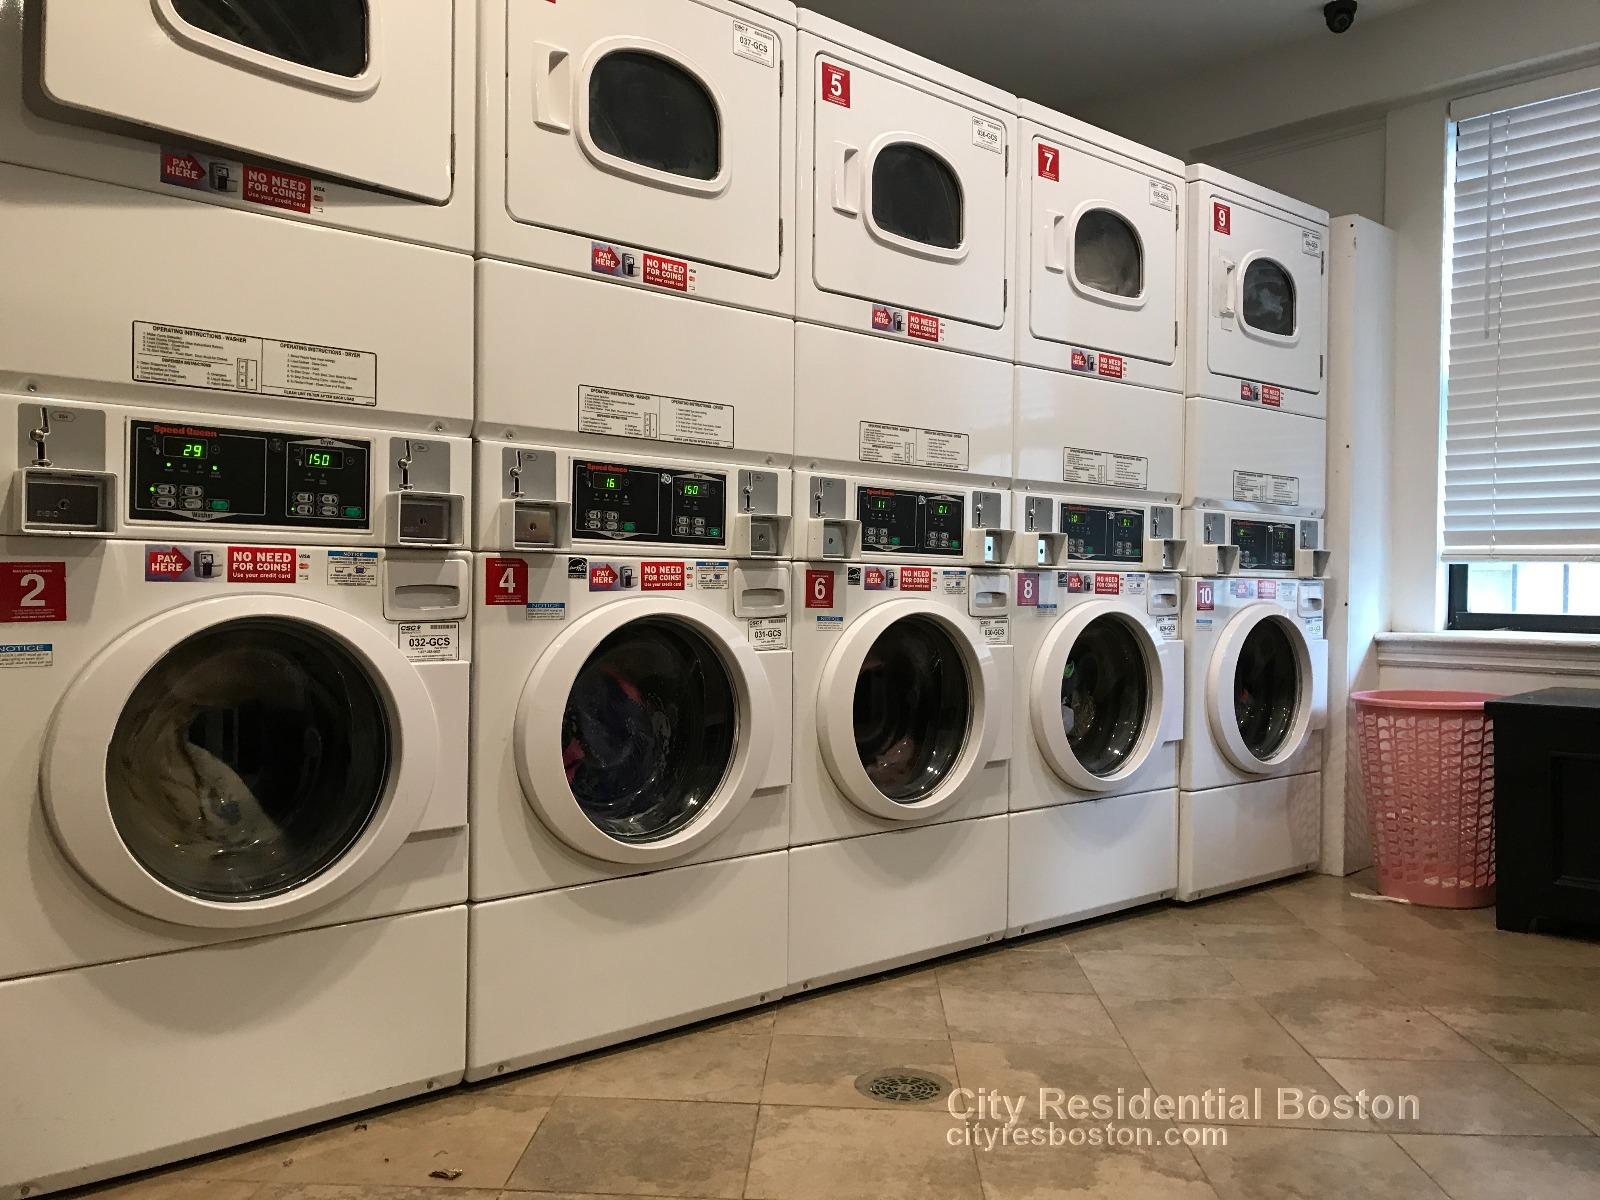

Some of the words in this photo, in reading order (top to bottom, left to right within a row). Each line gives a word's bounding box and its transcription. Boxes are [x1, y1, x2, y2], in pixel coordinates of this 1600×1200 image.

[740, 36, 768, 52] 037-GCS
[831, 74, 842, 96] 5
[172, 158, 193, 170] PAY
[1044, 152, 1054, 172] 7
[167, 165, 198, 180] HERE
[248, 170, 266, 182] NO
[272, 176, 306, 192] NEED
[248, 182, 268, 192] FOR
[272, 186, 306, 200] COINS!
[261, 194, 273, 202] your
[274, 196, 292, 206] credit
[1219, 210, 1226, 226] 9
[598, 252, 612, 260] PAY
[595, 258, 615, 268] HERE
[647, 258, 658, 268] NO
[662, 262, 684, 273] NEED
[646, 268, 660, 276] FOR
[662, 270, 684, 281] COINS!
[910, 316, 919, 324] NO
[921, 318, 936, 327] NEED
[152, 326, 183, 335] OPERATING
[184, 330, 222, 340] INSTRUCTIONS
[921, 325, 936, 334] COINS!
[280, 343, 307, 351] OPERATING
[308, 346, 342, 356] INSTRUCTIONS
[154, 424, 185, 435] Speed
[186, 428, 217, 438] Queen
[184, 444, 202, 456] 29
[308, 454, 330, 466] 150
[606, 478, 614, 488] 16
[684, 485, 698, 494] 150
[157, 554, 178, 562] PAY
[233, 552, 251, 562] NO
[256, 552, 292, 562] NEED
[152, 563, 182, 572] HERE
[233, 563, 254, 571] FOR
[256, 563, 291, 572] COINS!
[499, 568, 516, 593] 4
[20, 574, 46, 606] 2
[815, 578, 826, 600] 6
[1024, 580, 1032, 598] 8
[1200, 588, 1212, 604] 10
[754, 630, 782, 638] 031-GCS
[409, 637, 450, 647] 032-GCS
